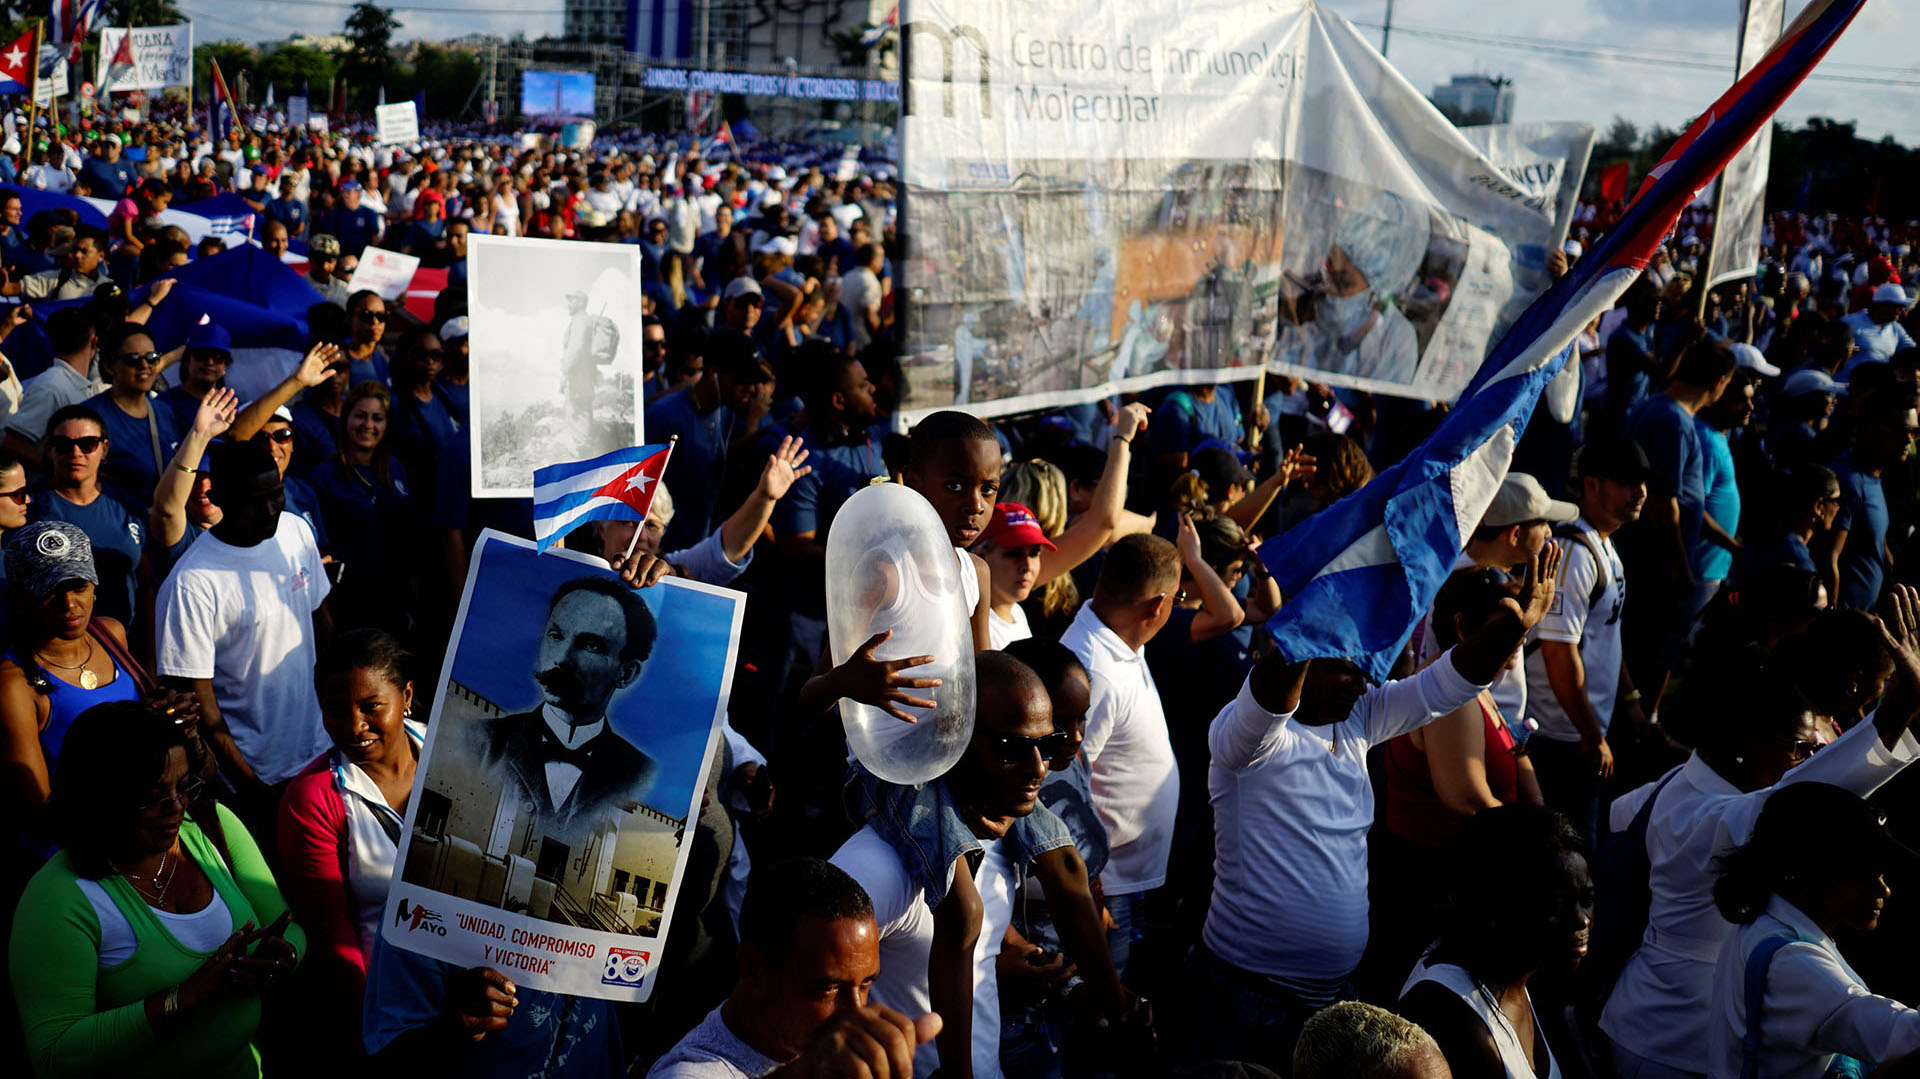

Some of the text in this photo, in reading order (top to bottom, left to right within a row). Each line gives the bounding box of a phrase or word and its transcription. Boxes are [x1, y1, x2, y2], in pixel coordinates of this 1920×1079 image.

[1011, 30, 1108, 71] Centro
[1117, 34, 1152, 73] de
[1014, 83, 1159, 122] Molecular
[511, 928, 596, 958] COMPROMISO
[484, 944, 556, 975] Y VICTORIA”
[604, 954, 646, 982] 80
